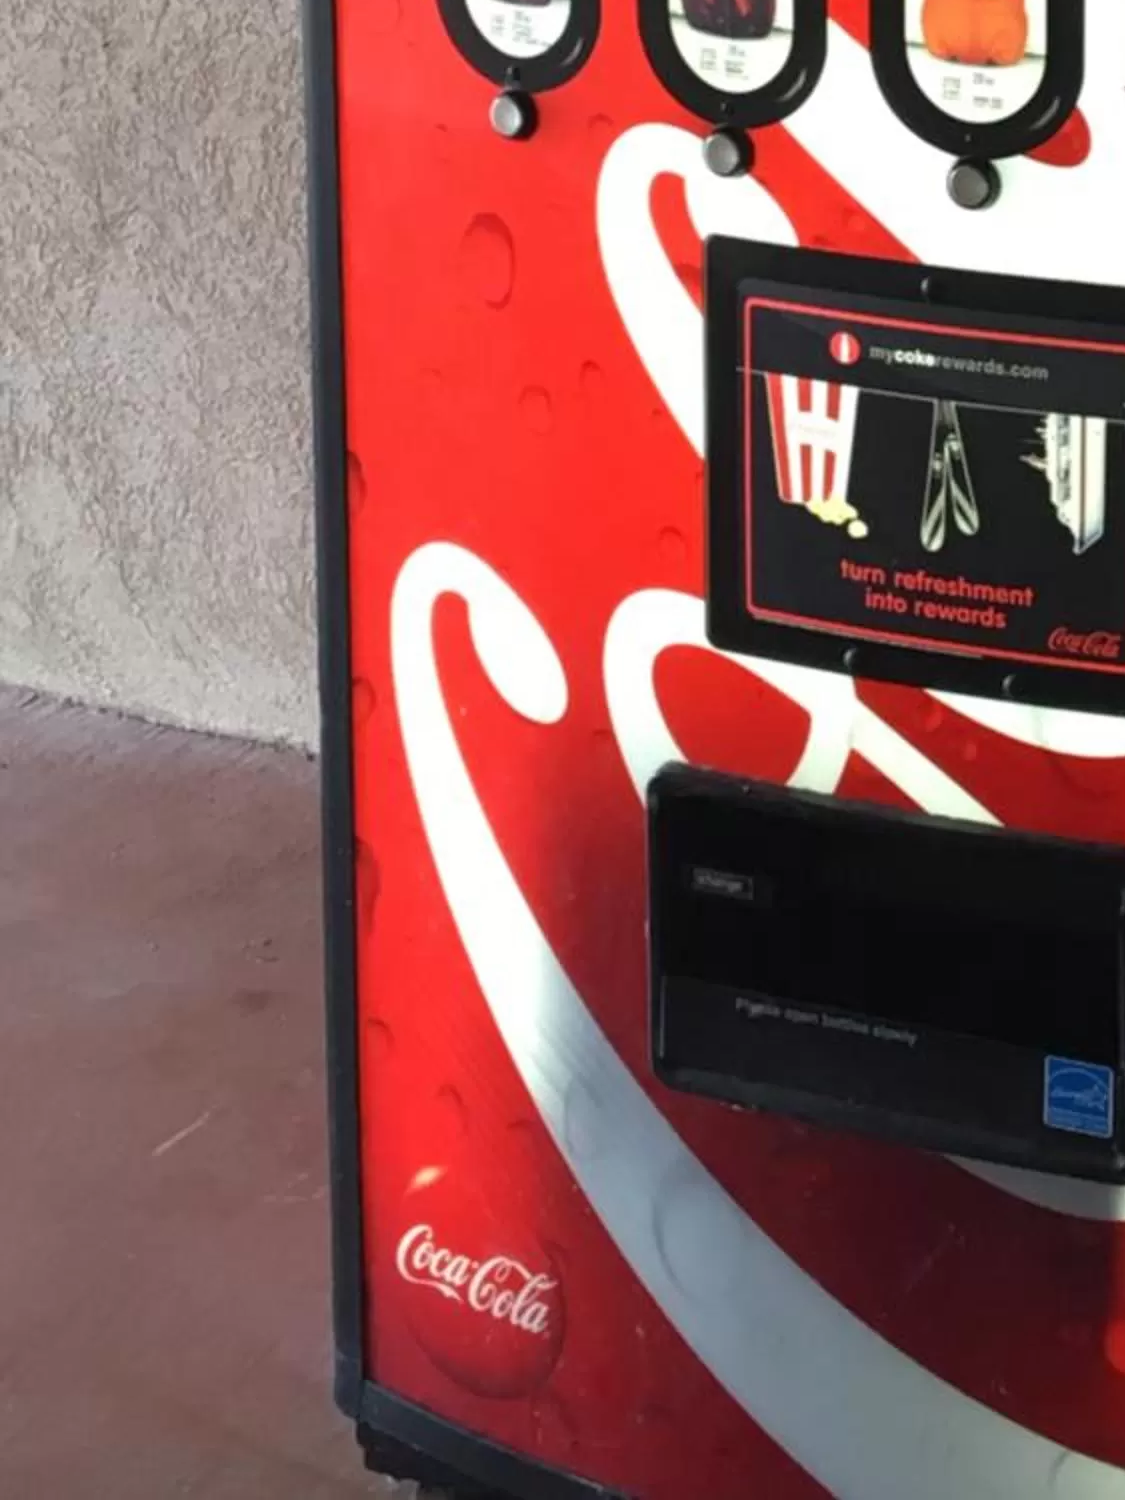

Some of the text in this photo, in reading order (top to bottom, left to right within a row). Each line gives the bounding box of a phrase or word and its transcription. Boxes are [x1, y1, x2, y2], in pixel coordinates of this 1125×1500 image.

[867, 344, 1050, 383] mycokerewards.com
[840, 557, 1034, 607] turn refreshment
[864, 587, 1007, 629] into rewards
[1046, 626, 1122, 659] Coca-Cola
[396, 1223, 558, 1334] Coca-Cola
